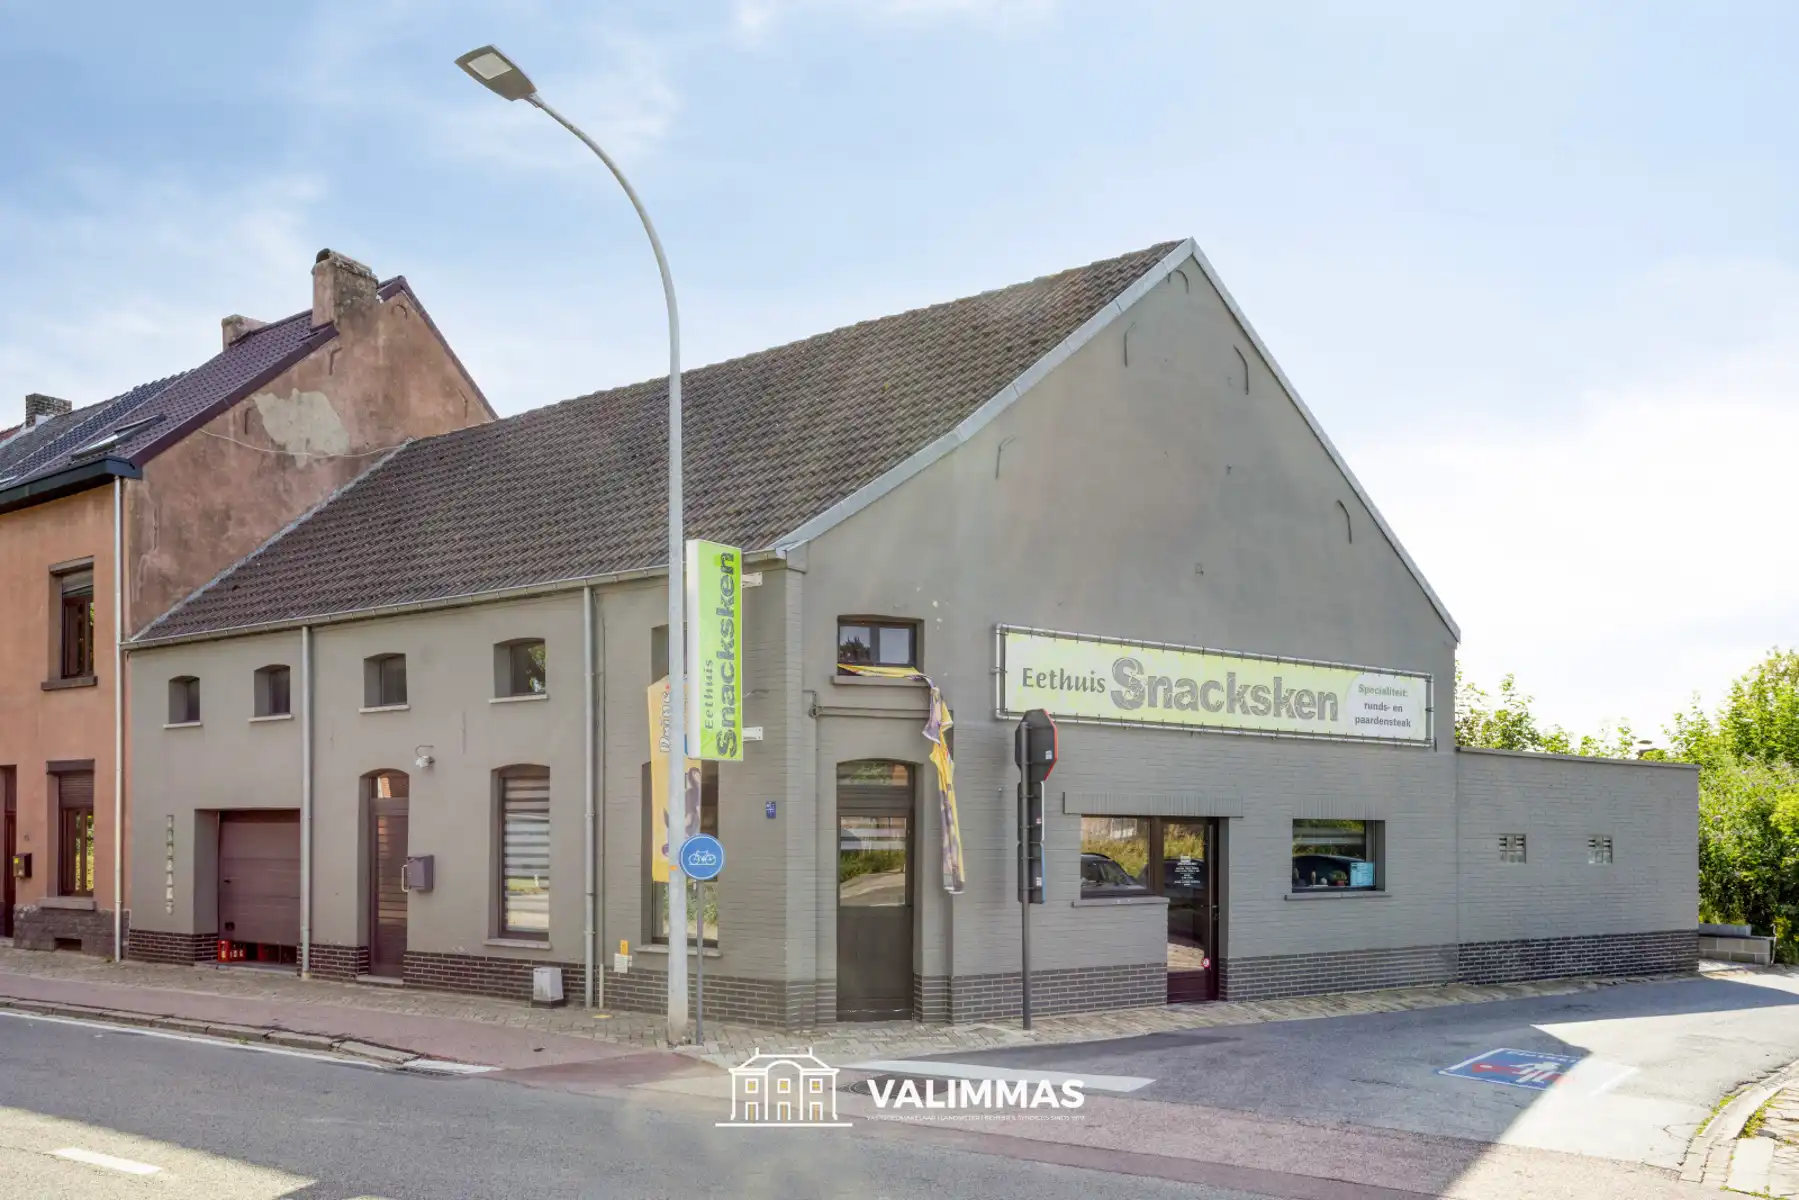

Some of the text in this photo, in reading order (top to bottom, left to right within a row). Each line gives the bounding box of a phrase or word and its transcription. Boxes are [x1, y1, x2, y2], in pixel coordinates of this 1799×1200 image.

[716, 551, 736, 758] Snacksken
[704, 658, 714, 731] Eethuis
[1022, 657, 1339, 722] Eethuis Snacksken
[1358, 683, 1409, 698] Specialiteit:
[1364, 701, 1403, 713] runds- en
[1354, 715, 1411, 728] paardensteak
